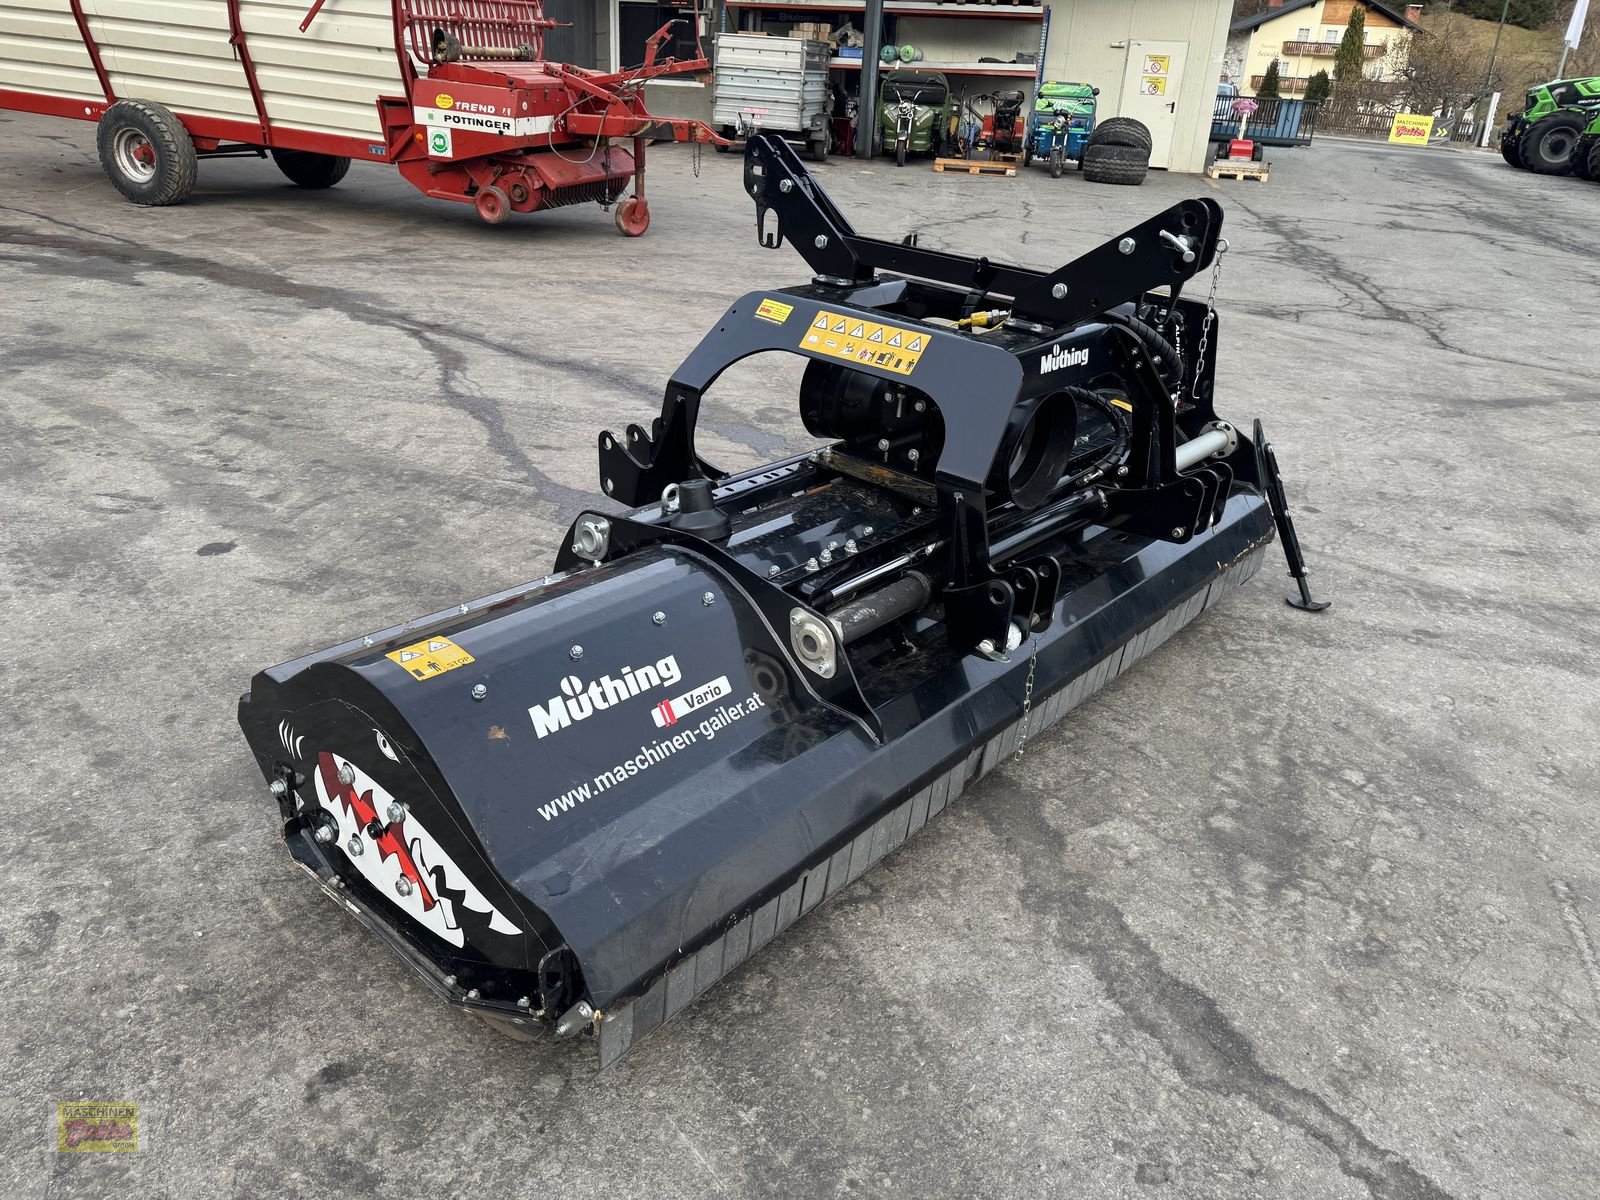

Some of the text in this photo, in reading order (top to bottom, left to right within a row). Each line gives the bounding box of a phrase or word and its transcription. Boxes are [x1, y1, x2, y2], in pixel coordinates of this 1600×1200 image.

[455, 101, 496, 114] TREND
[444, 114, 511, 131] PÖTTINGER
[446, 656, 470, 668] STOP
[683, 683, 722, 709] Vario
[536, 691, 766, 822] www.maschinen-gailer.at
